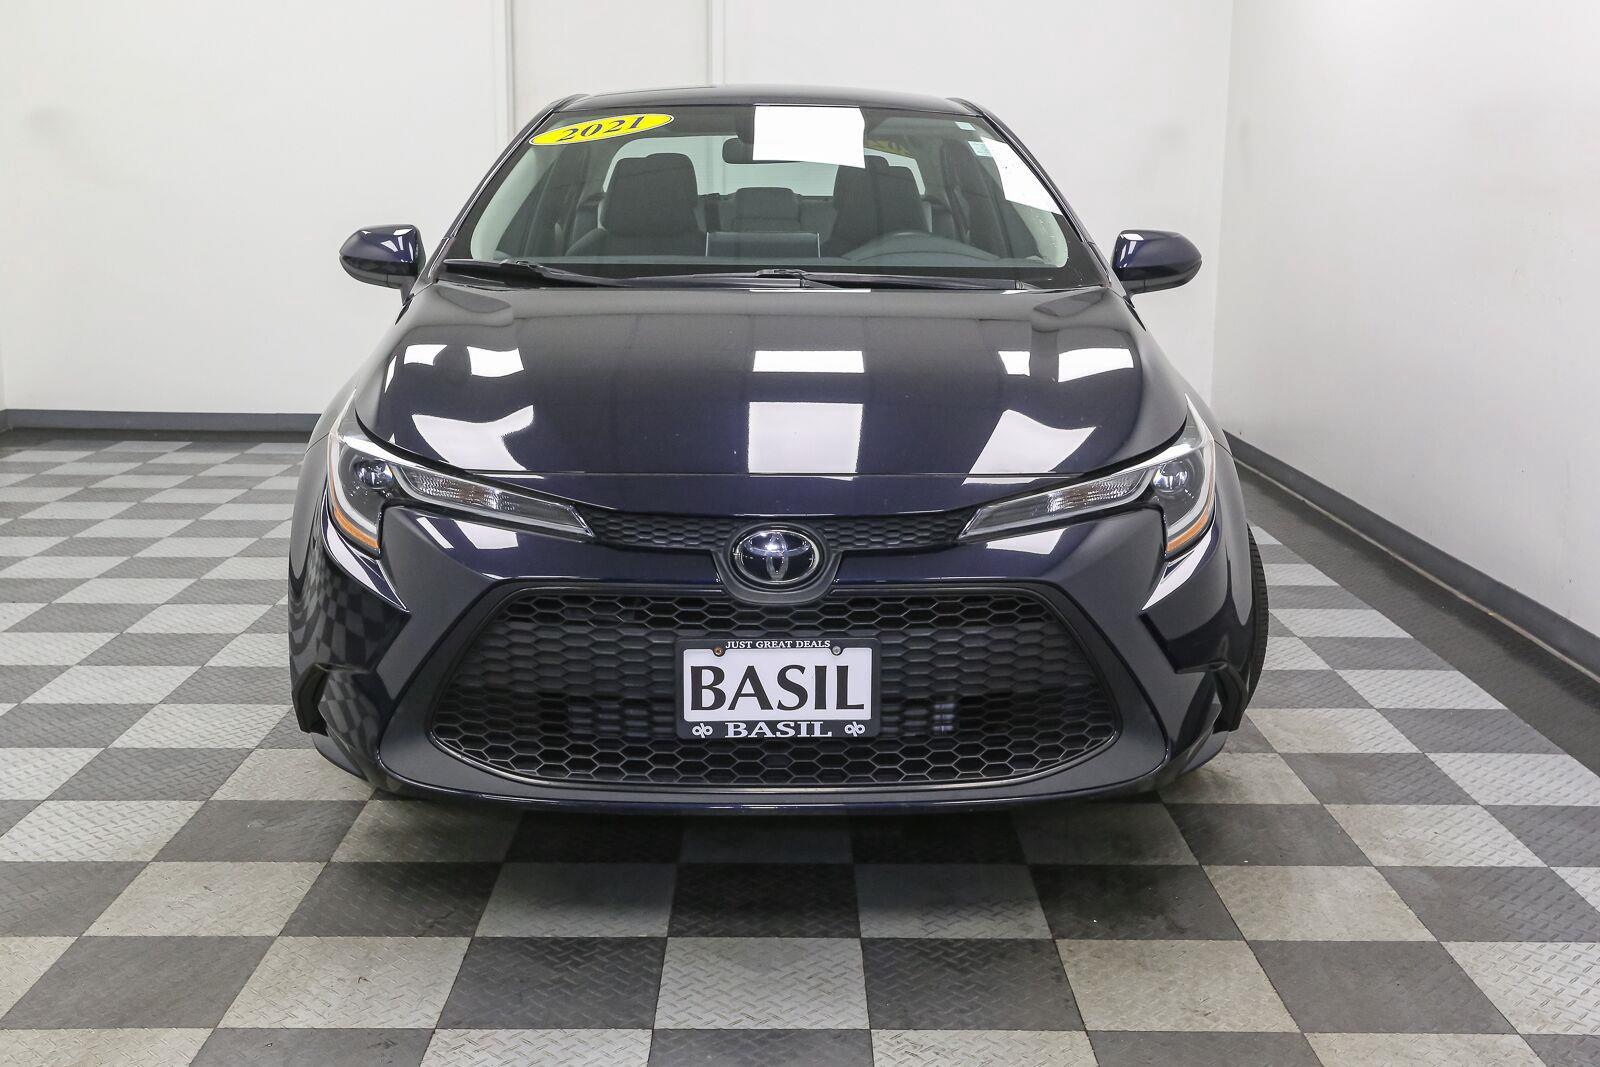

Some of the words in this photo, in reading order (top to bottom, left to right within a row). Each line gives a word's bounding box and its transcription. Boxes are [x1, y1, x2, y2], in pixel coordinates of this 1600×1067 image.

[557, 115, 644, 142] 2021
[725, 640, 753, 649] JUST
[756, 640, 793, 649] GREAT
[795, 640, 831, 648] DEALS
[690, 664, 865, 711] BASIL
[724, 721, 833, 738] BASIL
